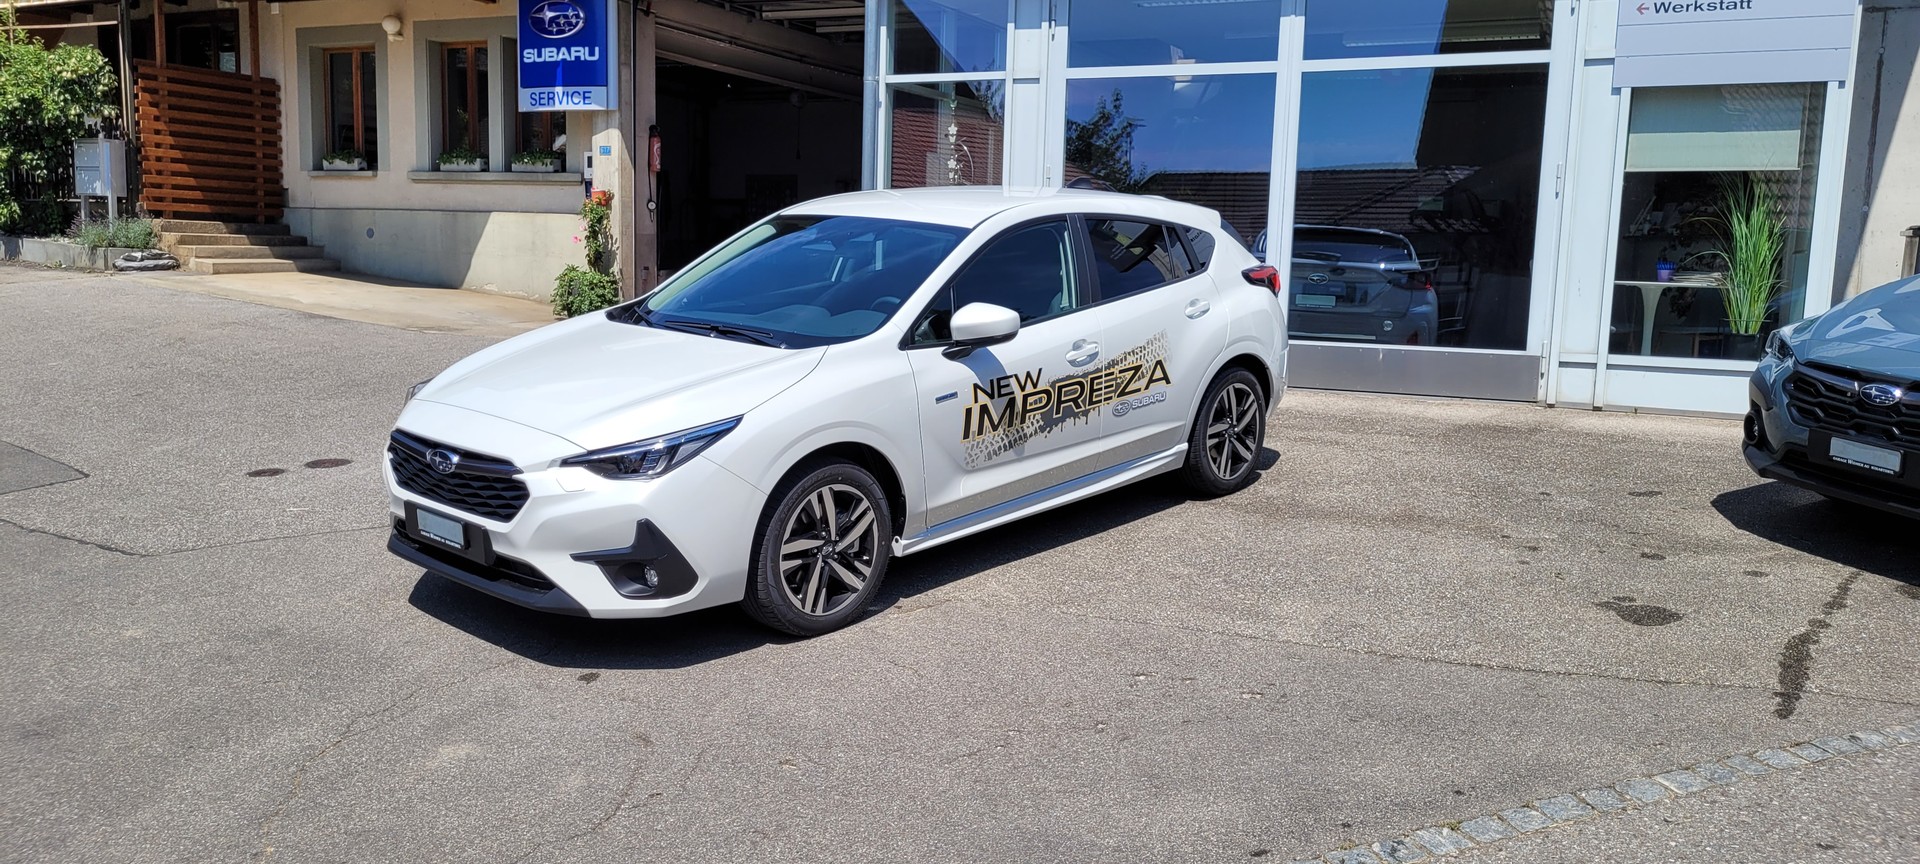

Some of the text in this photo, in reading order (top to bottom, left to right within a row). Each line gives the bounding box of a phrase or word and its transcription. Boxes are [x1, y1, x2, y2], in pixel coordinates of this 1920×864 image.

[1653, 0, 1752, 14] Werkstatt
[523, 46, 600, 63] SUBARU
[529, 90, 593, 107] SERVICE
[972, 367, 1043, 404] NEW
[961, 358, 1172, 443] IMPREZA
[1131, 390, 1167, 410] SUBARU
